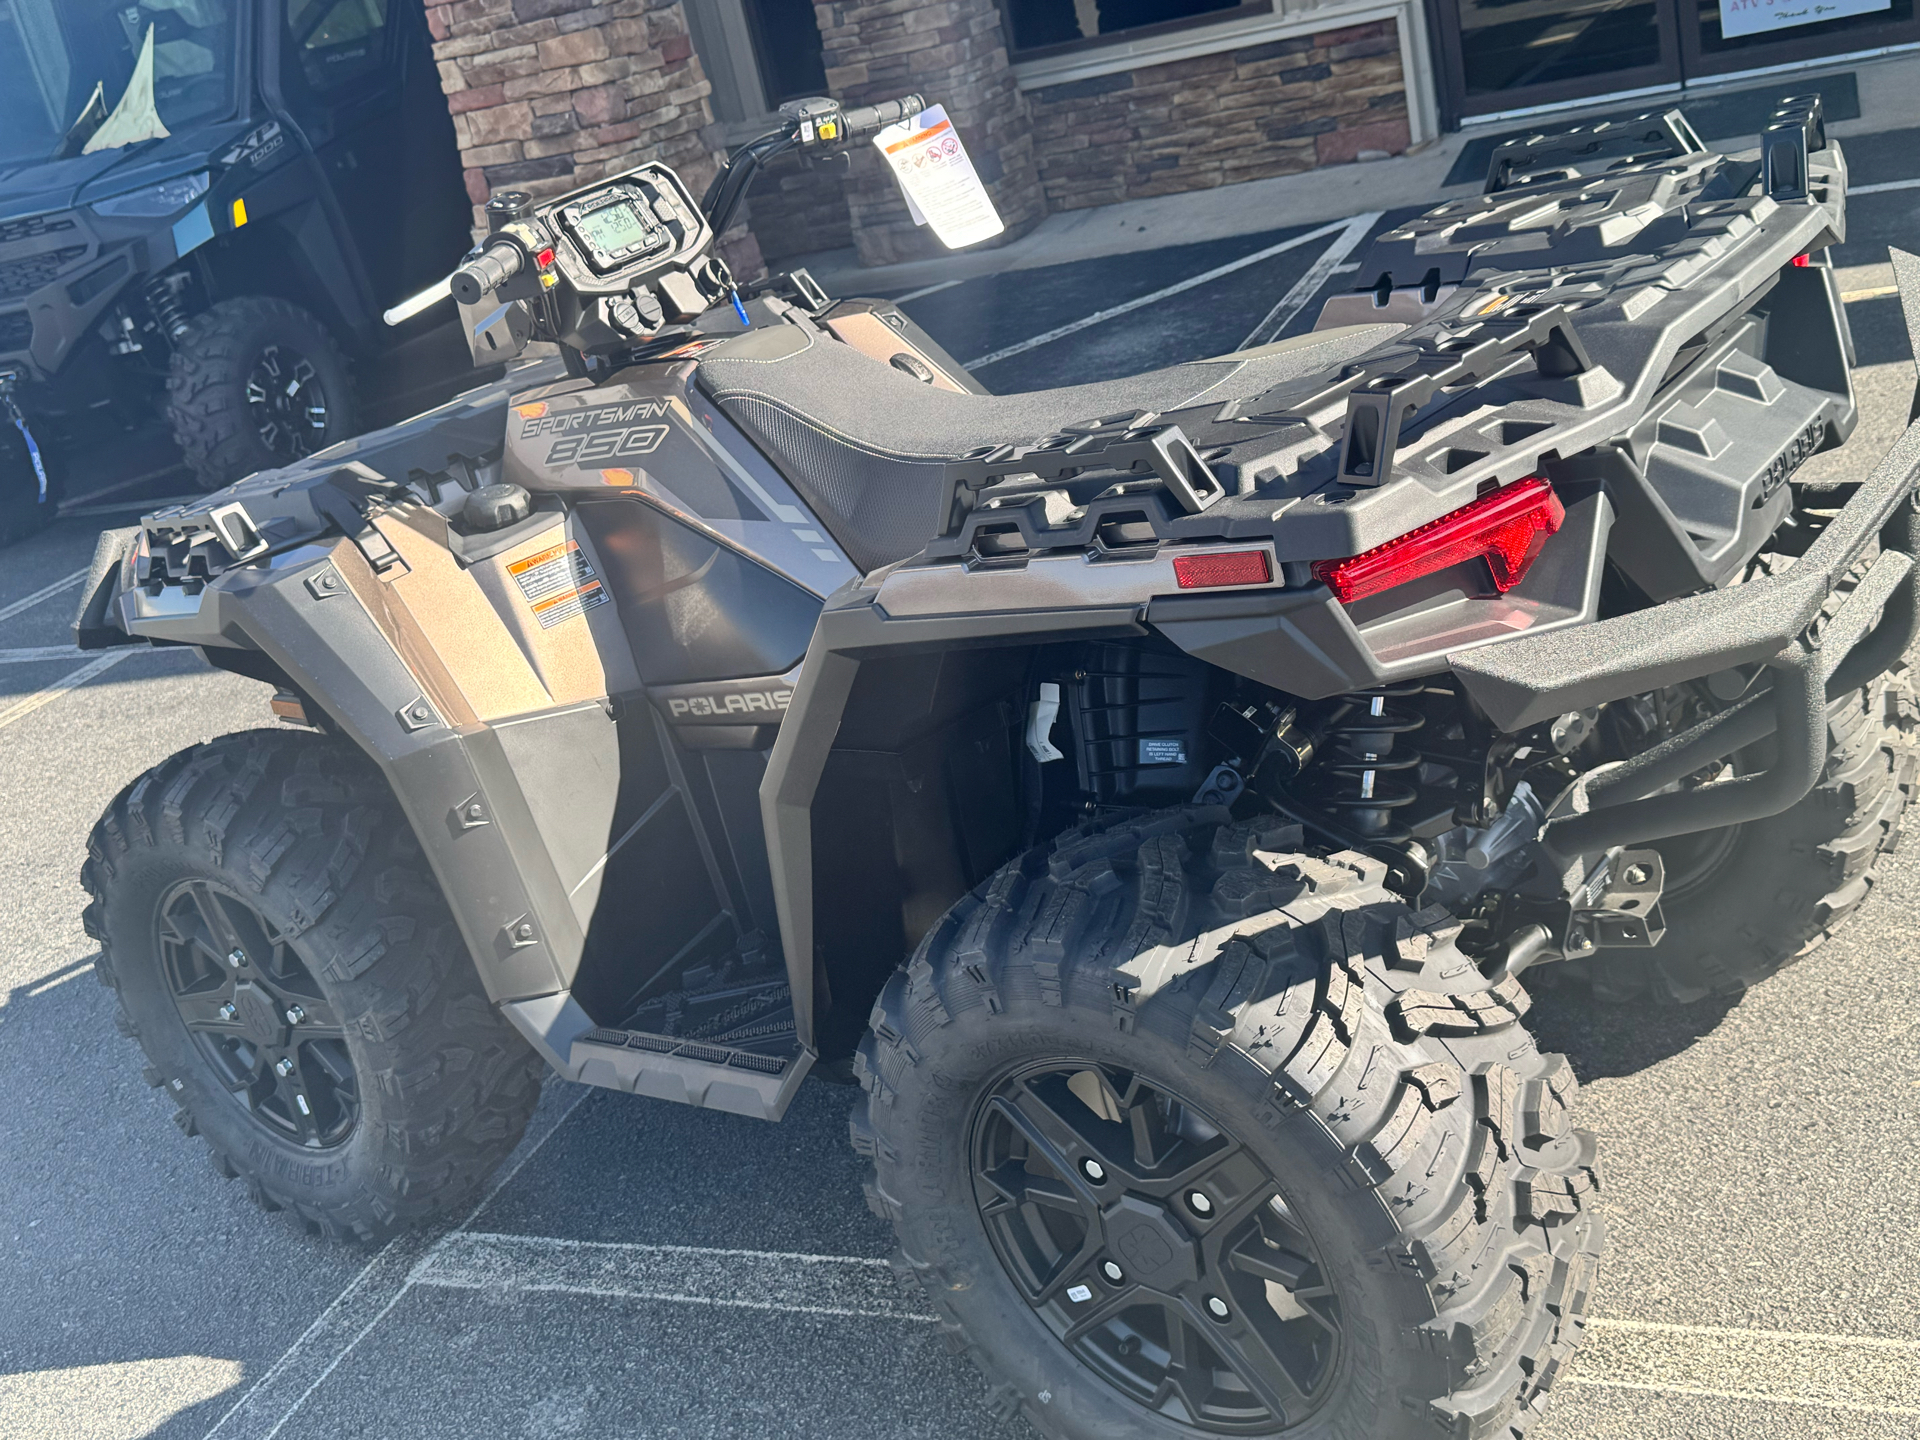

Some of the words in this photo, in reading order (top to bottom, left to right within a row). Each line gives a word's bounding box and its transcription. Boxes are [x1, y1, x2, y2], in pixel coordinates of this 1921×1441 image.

[1774, 10, 1809, 20] Thank
[1814, 6, 1836, 15] You
[221, 120, 281, 164] XP
[250, 136, 284, 163] 1000
[522, 401, 671, 438] SPORTSMAN
[544, 424, 670, 467] 850
[1762, 414, 1824, 500] POLARIS
[668, 690, 791, 717] POLARIS
